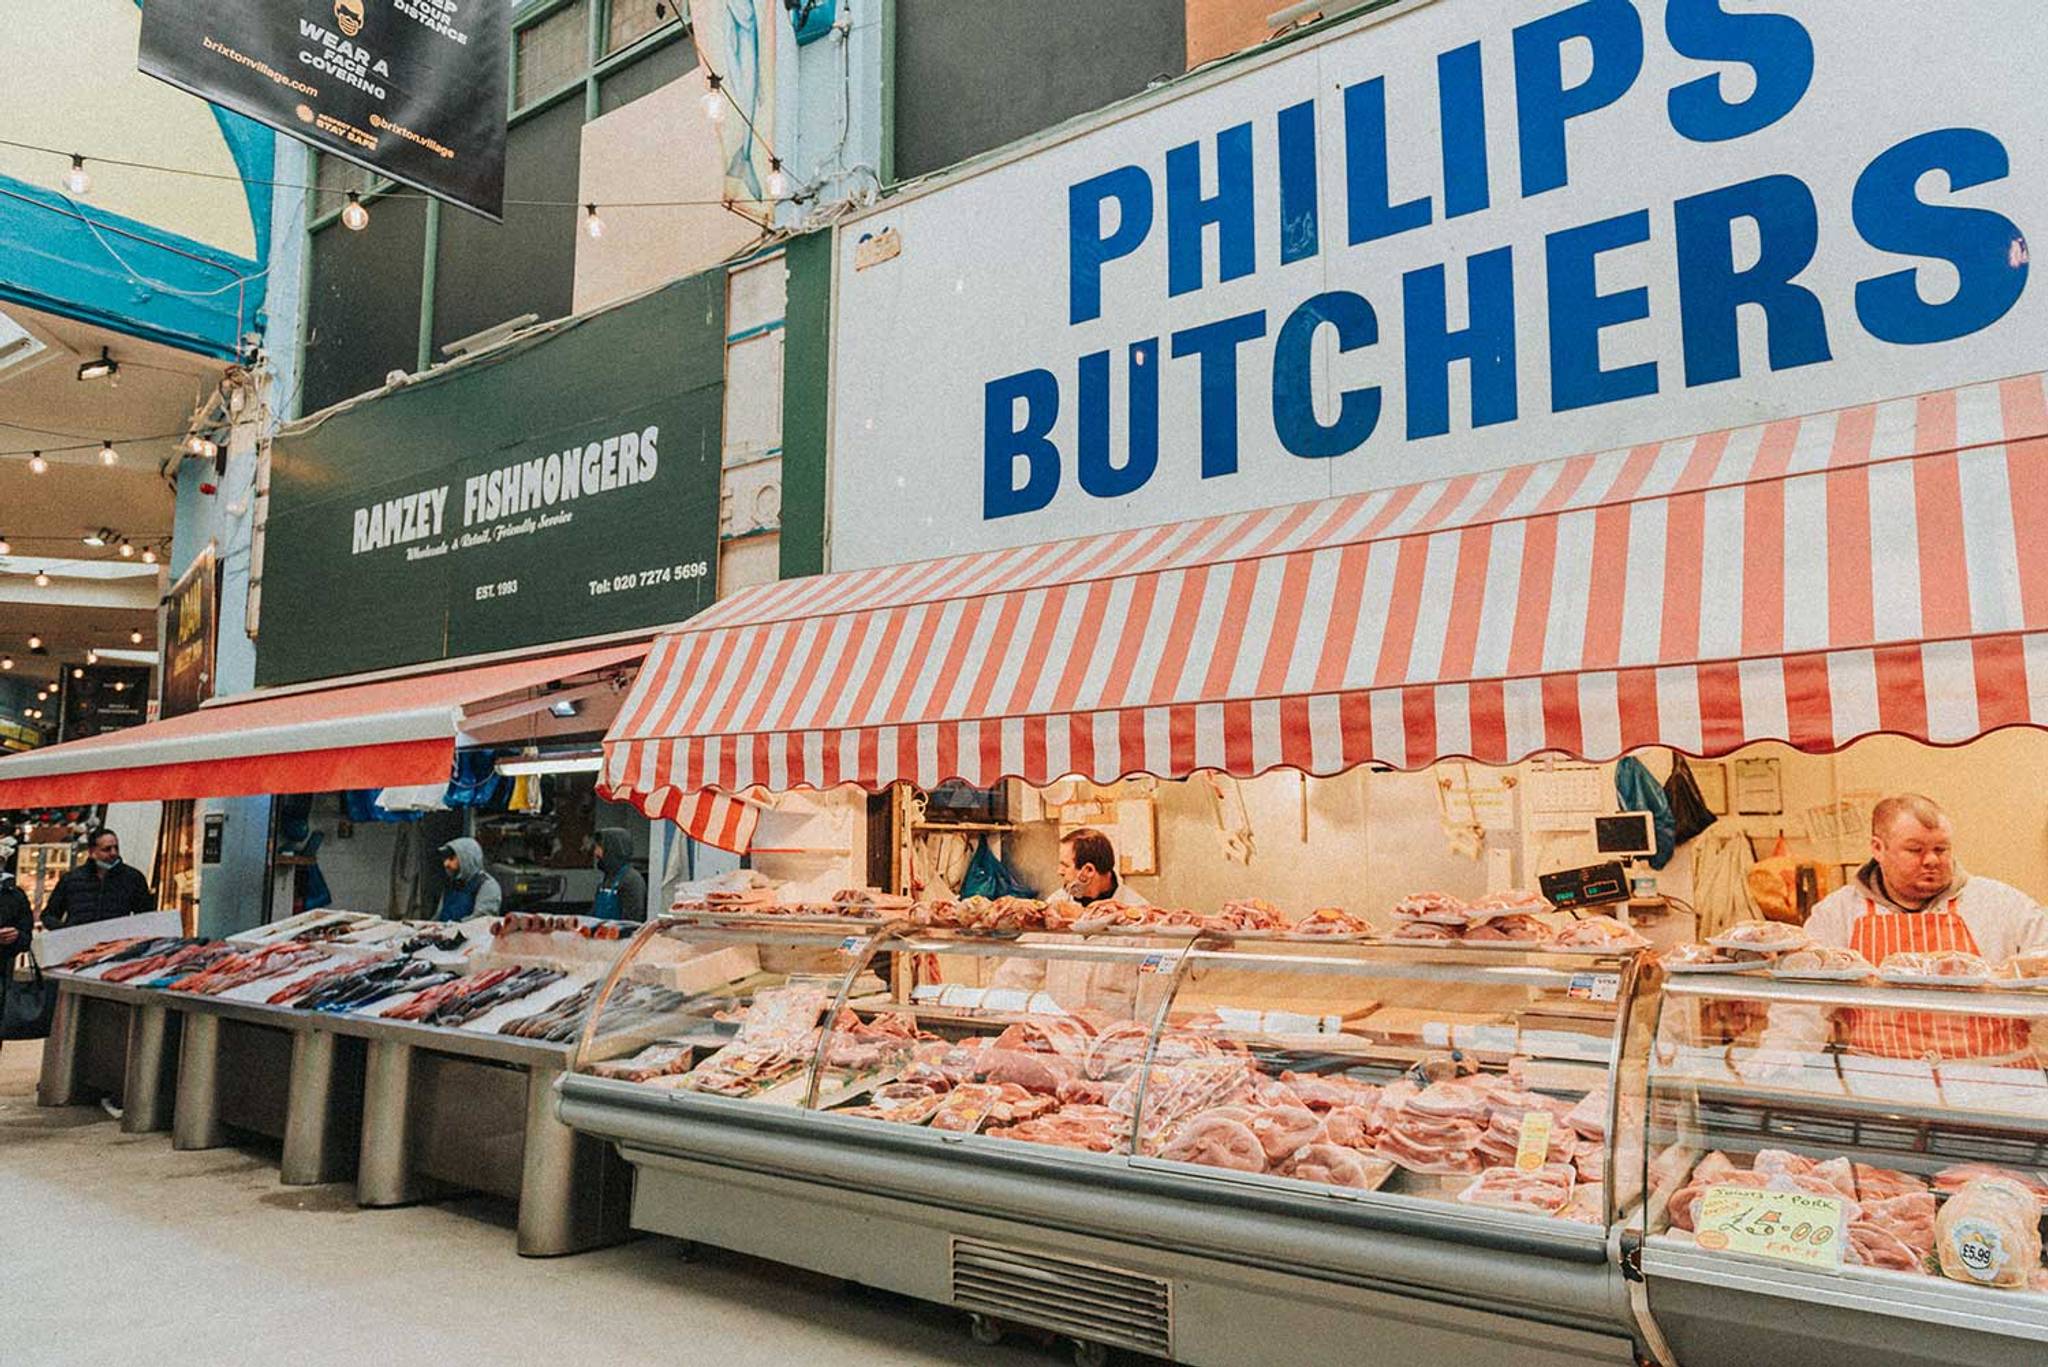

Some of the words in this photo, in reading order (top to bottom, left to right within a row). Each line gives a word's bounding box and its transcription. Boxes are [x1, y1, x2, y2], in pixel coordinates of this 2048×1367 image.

[393, 0, 468, 45] DISTANCE
[412, 0, 452, 26] YOUR
[203, 36, 319, 98] brixtonvillage.com
[299, 19, 371, 67] WEAR
[372, 58, 390, 78] A
[323, 50, 367, 77] FACE
[298, 51, 386, 100] COVERING
[316, 118, 347, 138] STAY
[346, 131, 378, 151] SAFE
[1070, 0, 1815, 325] PHILIPS
[982, 127, 2030, 520] BUTCHERS
[352, 485, 449, 555] RAMZEY
[463, 425, 659, 527] FISHMONGERS
[493, 516, 537, 542] Friendly
[537, 509, 573, 529] Service
[475, 584, 494, 600] EST.
[496, 579, 518, 596] 1993
[588, 580, 611, 596] Tel:
[613, 573, 637, 592] 020
[640, 567, 671, 586] 7274
[674, 561, 708, 581] 5696
[1962, 1242, 1992, 1265] £5.99
